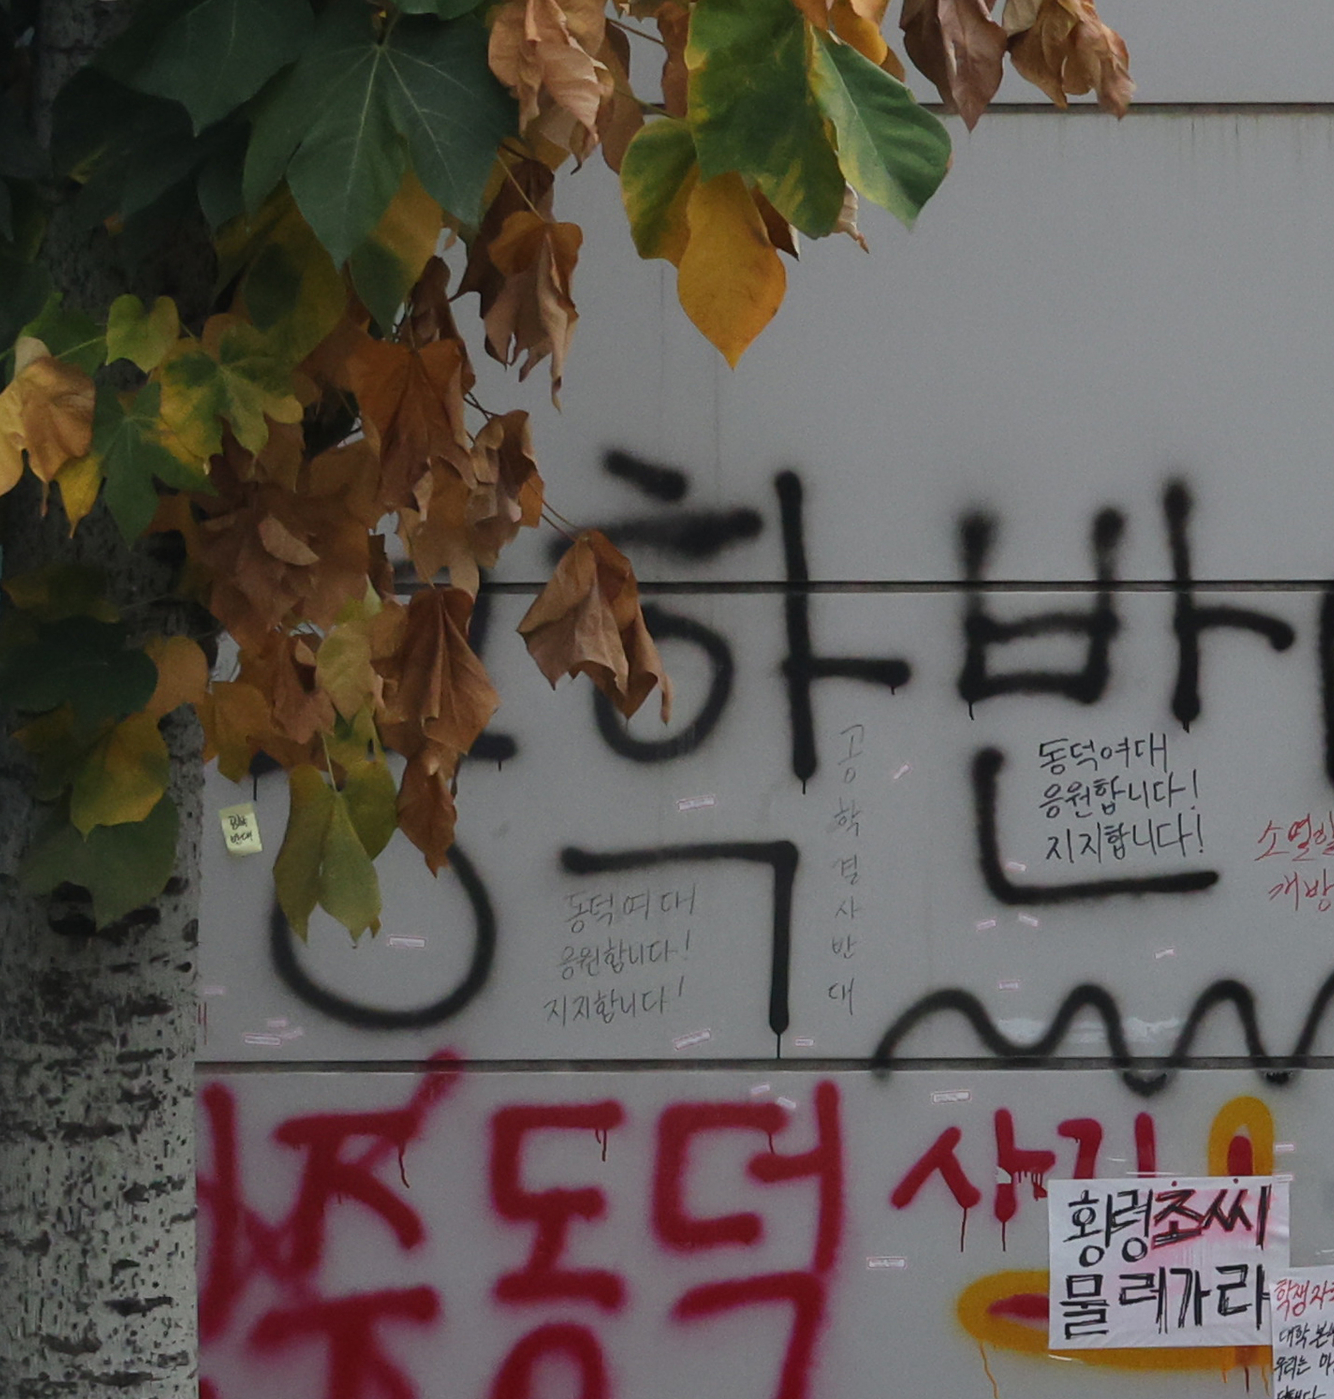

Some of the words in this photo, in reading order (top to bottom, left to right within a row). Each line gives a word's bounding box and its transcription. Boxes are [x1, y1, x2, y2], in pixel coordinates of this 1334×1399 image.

[1038, 731, 1169, 776] 동덕여대
[1038, 768, 1200, 820] 응원합니다!
[1046, 812, 1206, 865] 지지합니다!
[565, 882, 697, 934] 동덕여대
[557, 928, 692, 981] 응원합니다!
[1059, 1263, 1272, 1341] 물러가라
[1273, 1355, 1312, 1382] 우리는
